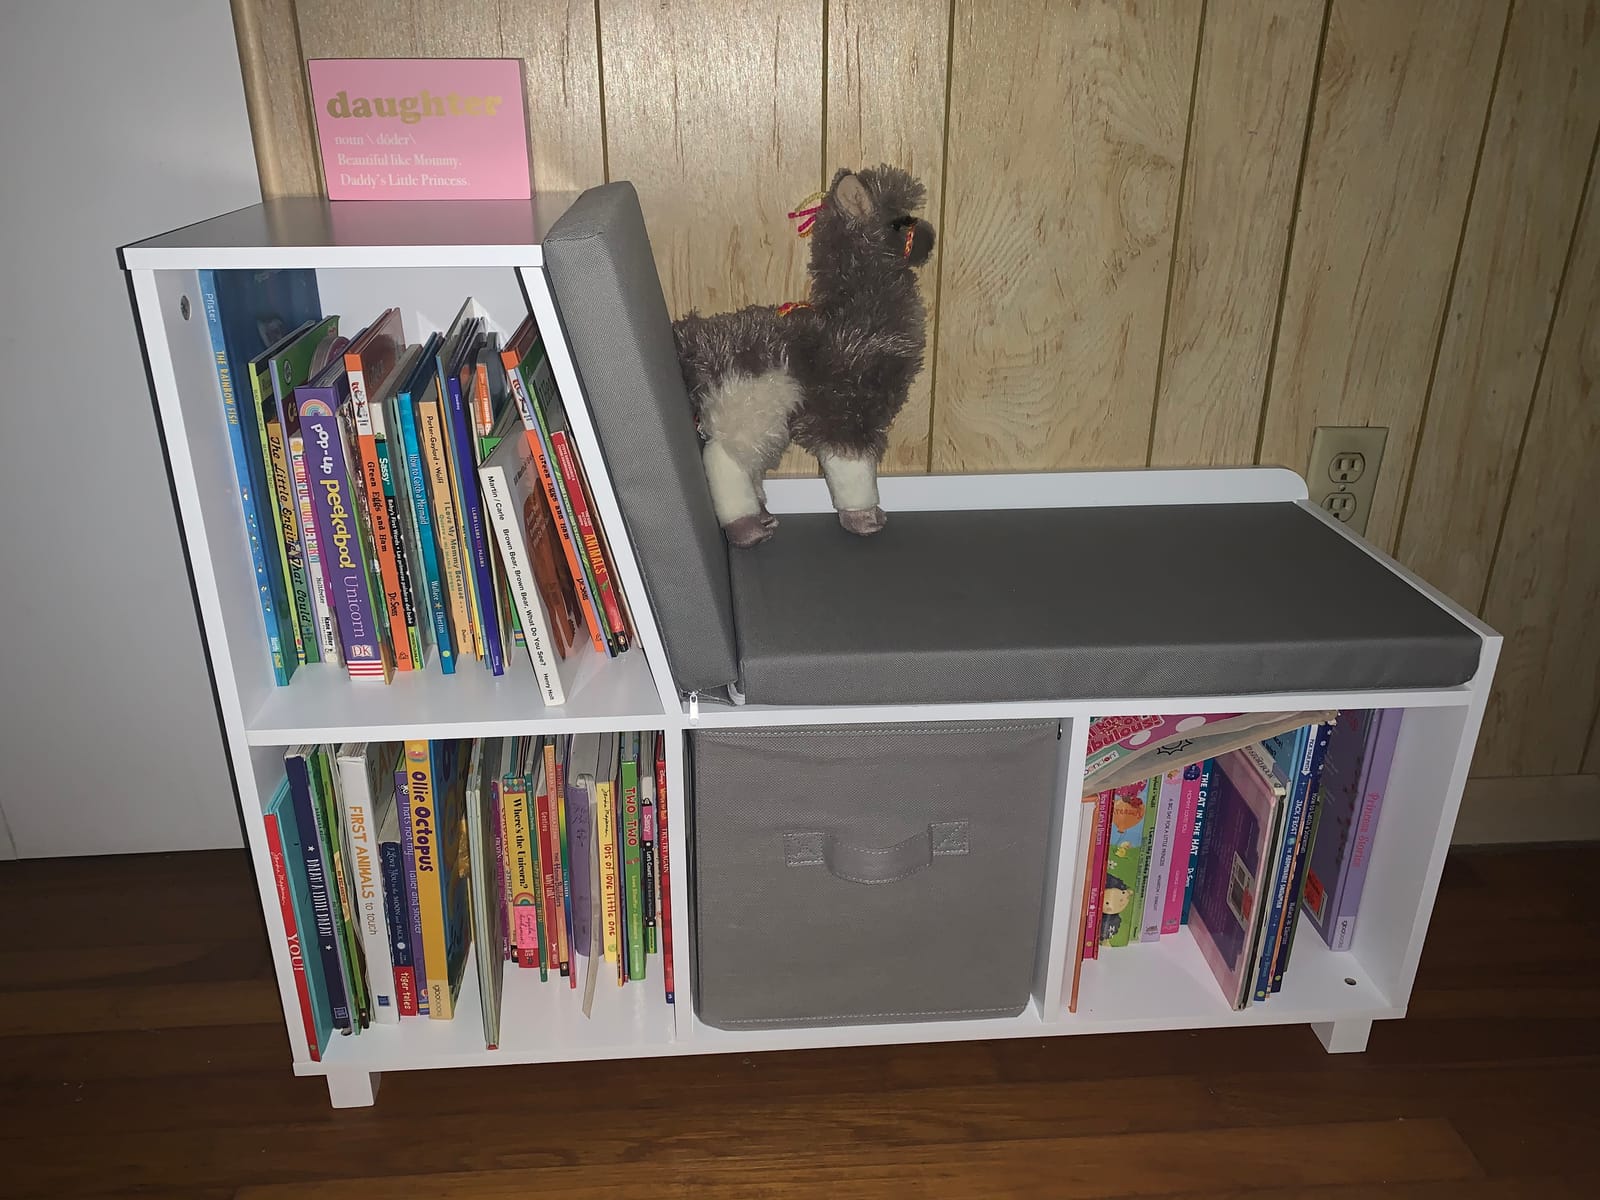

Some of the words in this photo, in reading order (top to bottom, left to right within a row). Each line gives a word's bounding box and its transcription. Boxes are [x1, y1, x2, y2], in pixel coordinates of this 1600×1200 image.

[326, 89, 503, 124] daughter
[335, 136, 364, 145] noun
[338, 152, 389, 166] Beautiful
[390, 153, 412, 166] like
[413, 153, 462, 169] Mommy.
[340, 173, 386, 189] Daddy's
[388, 173, 419, 186] Little
[420, 173, 472, 187] Princess.
[215, 350, 227, 366] THE
[219, 368, 234, 406] RAINBOW
[227, 406, 240, 425] FISH
[271, 437, 282, 459] The
[310, 423, 334, 475] pop-up
[380, 457, 391, 482] Sassy
[408, 454, 419, 470] How
[274, 462, 289, 502] Little
[293, 454, 310, 501] COLORFUL
[367, 461, 377, 487] Green
[412, 469, 419, 477] to
[413, 476, 424, 493] Catch
[487, 475, 498, 498] Martin
[372, 491, 382, 512] Eggs
[387, 498, 396, 516] Baby's
[538, 454, 551, 479] Green
[547, 482, 559, 503] Eggs
[554, 503, 564, 520] and
[559, 521, 570, 541] Ham
[416, 498, 430, 525] Mermaid
[444, 506, 452, 525] Love
[495, 503, 505, 521] Carle
[282, 507, 297, 552] Engine
[320, 480, 356, 569] peekaboo!
[376, 516, 386, 531] and
[447, 526, 454, 538] My
[379, 534, 388, 552] Ham
[502, 528, 514, 552] Brown
[450, 539, 459, 568] Mommy
[509, 551, 519, 570] Bear,
[583, 534, 607, 575] ANIMALS
[290, 559, 305, 584] That
[514, 569, 525, 591] Brown
[455, 570, 464, 599] Because
[296, 590, 311, 622] Could
[343, 575, 366, 638] Unicorn
[520, 591, 529, 610] Bear,
[526, 609, 535, 628] What
[530, 627, 537, 637] Do
[353, 645, 373, 657] DK
[533, 636, 542, 651] You
[537, 650, 547, 667] See?
[543, 673, 551, 689] Henry
[412, 771, 429, 803] Ollie
[1201, 772, 1209, 788] THE
[625, 786, 638, 814] TWO
[1199, 791, 1207, 807] CAT
[1295, 799, 1304, 814] JACK
[513, 798, 525, 834] Where's
[1196, 810, 1204, 819] IN
[1361, 791, 1380, 833] Princess
[349, 806, 367, 843] FIRST
[643, 814, 652, 833] Sassy
[1194, 821, 1202, 836] THE
[1290, 814, 1300, 836] FROST
[405, 826, 413, 841] not
[414, 806, 434, 872] Octopus
[516, 836, 526, 849] the
[626, 820, 639, 847] TWO
[1096, 827, 1105, 846] Unicorn
[603, 843, 613, 861] lots
[1190, 838, 1199, 856] HAT
[306, 859, 322, 883] DREAM
[355, 846, 375, 900] ANIMALS
[517, 850, 529, 889] Unicorn?
[604, 861, 613, 870] of
[605, 874, 614, 889] love
[312, 890, 330, 913] LITTLE
[365, 902, 374, 912] to
[606, 892, 616, 918] little
[317, 914, 333, 937] DREAM
[366, 913, 377, 936] touch
[608, 920, 616, 937] one
[287, 933, 304, 972] YOU!
[400, 972, 409, 991] tiger
[403, 992, 412, 1010] tales
